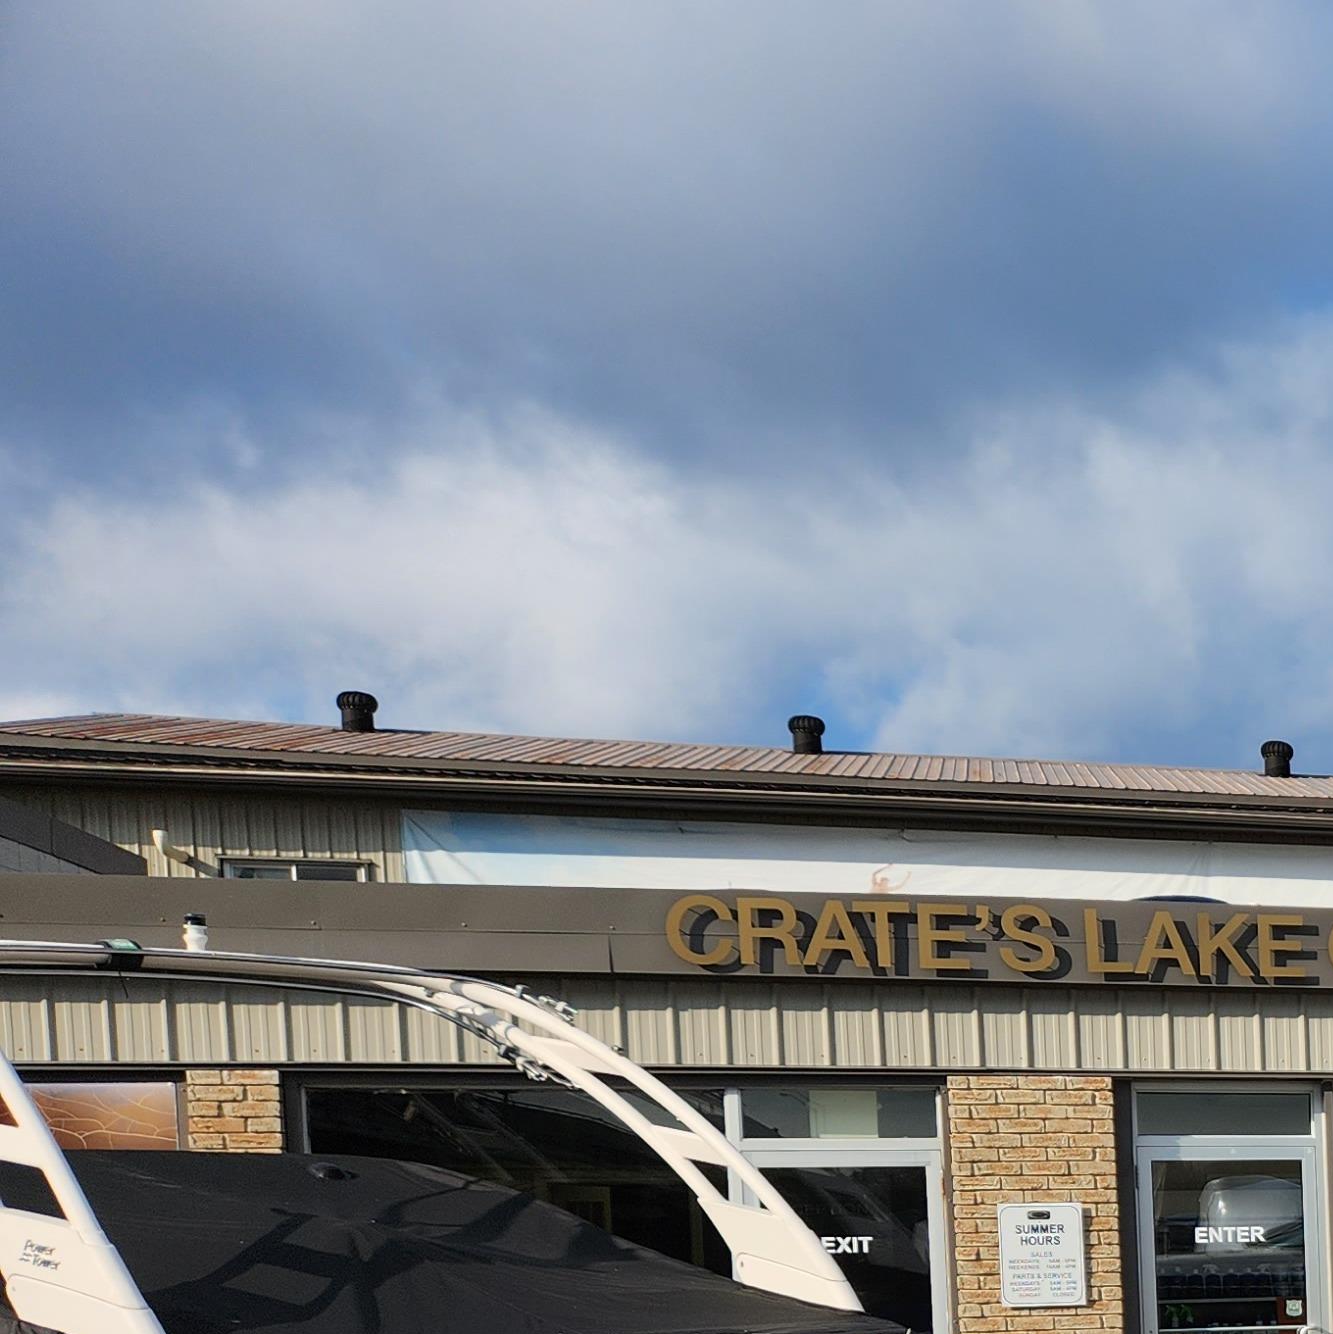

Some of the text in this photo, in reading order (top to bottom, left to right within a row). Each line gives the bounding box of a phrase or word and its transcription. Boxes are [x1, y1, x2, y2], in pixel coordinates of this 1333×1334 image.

[665, 895, 1056, 972] CRATE'S
[1083, 908, 1306, 978] LAKE
[1015, 1224, 1065, 1235] SUMMER
[1194, 1226, 1267, 1244] ENTER
[820, 1236, 874, 1254] EXIT
[1020, 1236, 1061, 1246] HOURS
